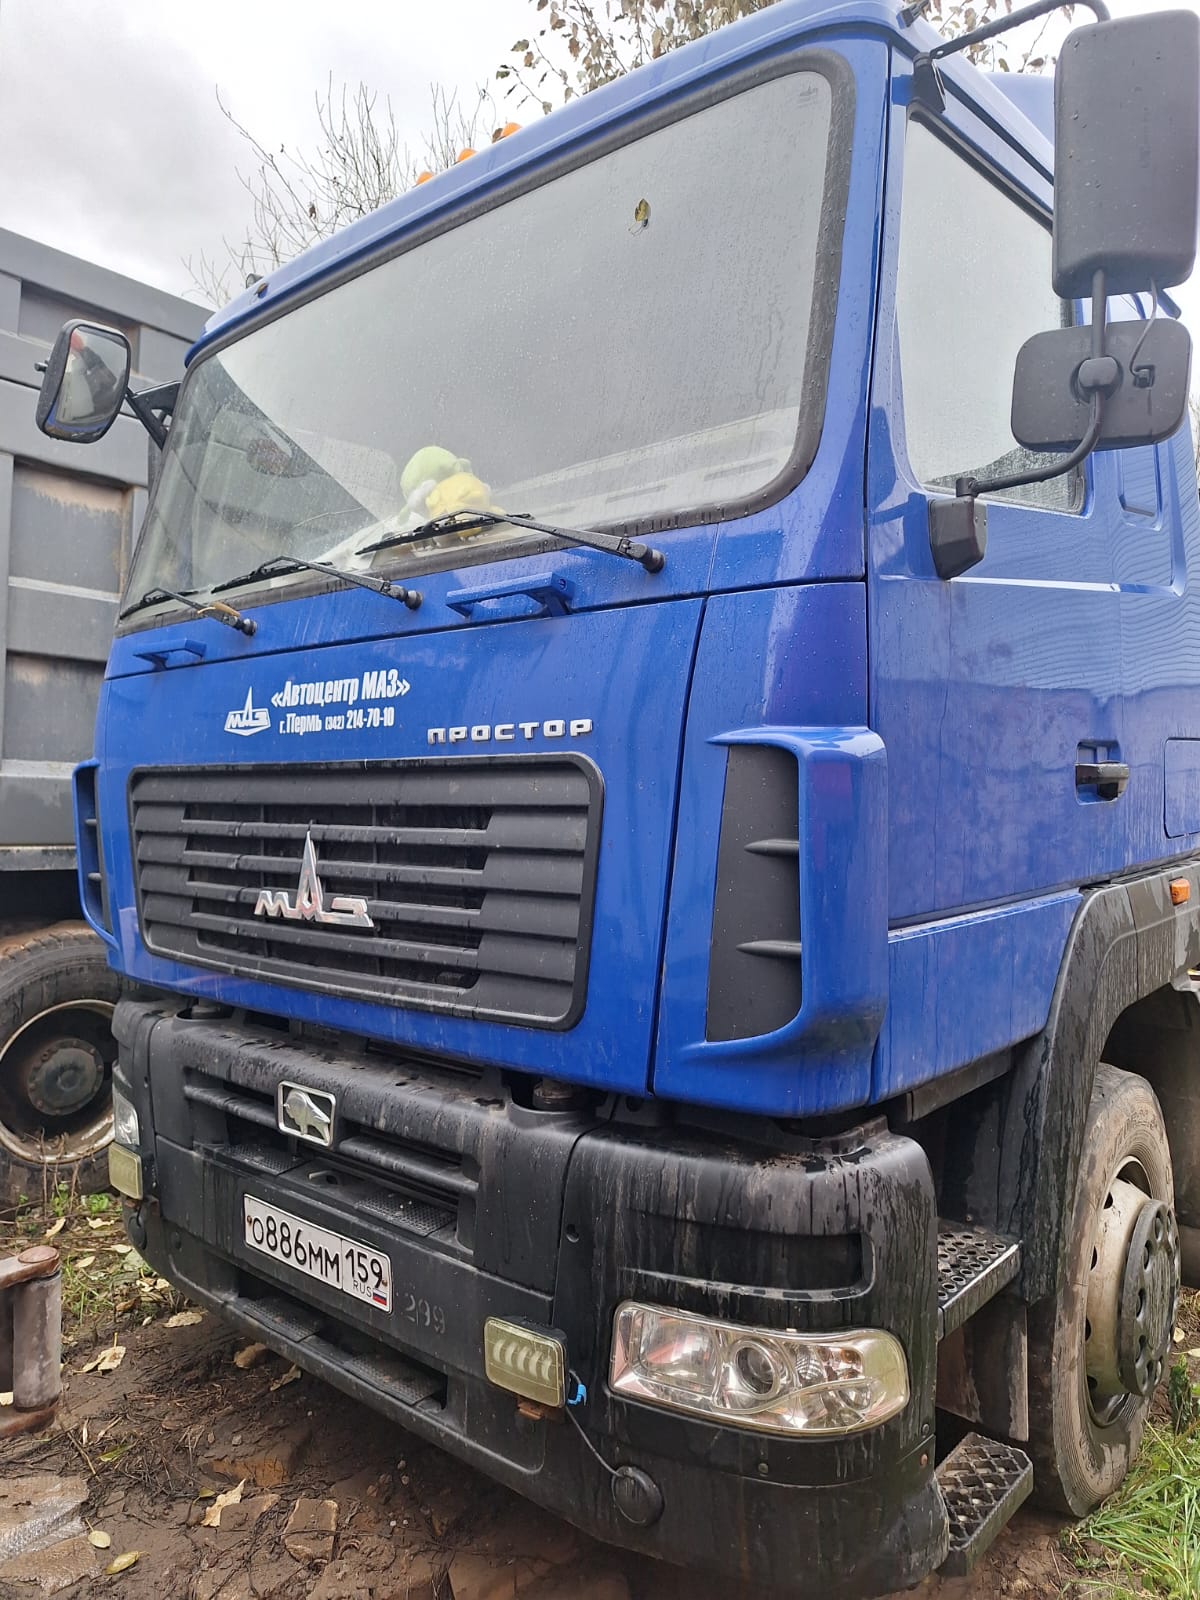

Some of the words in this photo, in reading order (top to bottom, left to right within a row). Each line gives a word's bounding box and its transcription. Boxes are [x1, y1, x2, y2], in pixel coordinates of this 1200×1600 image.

[271, 678, 359, 708] «Автоцентр
[361, 669, 411, 700] МАЗ»
[325, 715, 345, 731] (342)
[346, 707, 395, 730] 214-70-10
[427, 719, 593, 745] ПРОСТОР
[252, 1215, 341, 1283] О886ММ
[345, 1248, 384, 1289] 159
[353, 1279, 373, 1299] RUS
